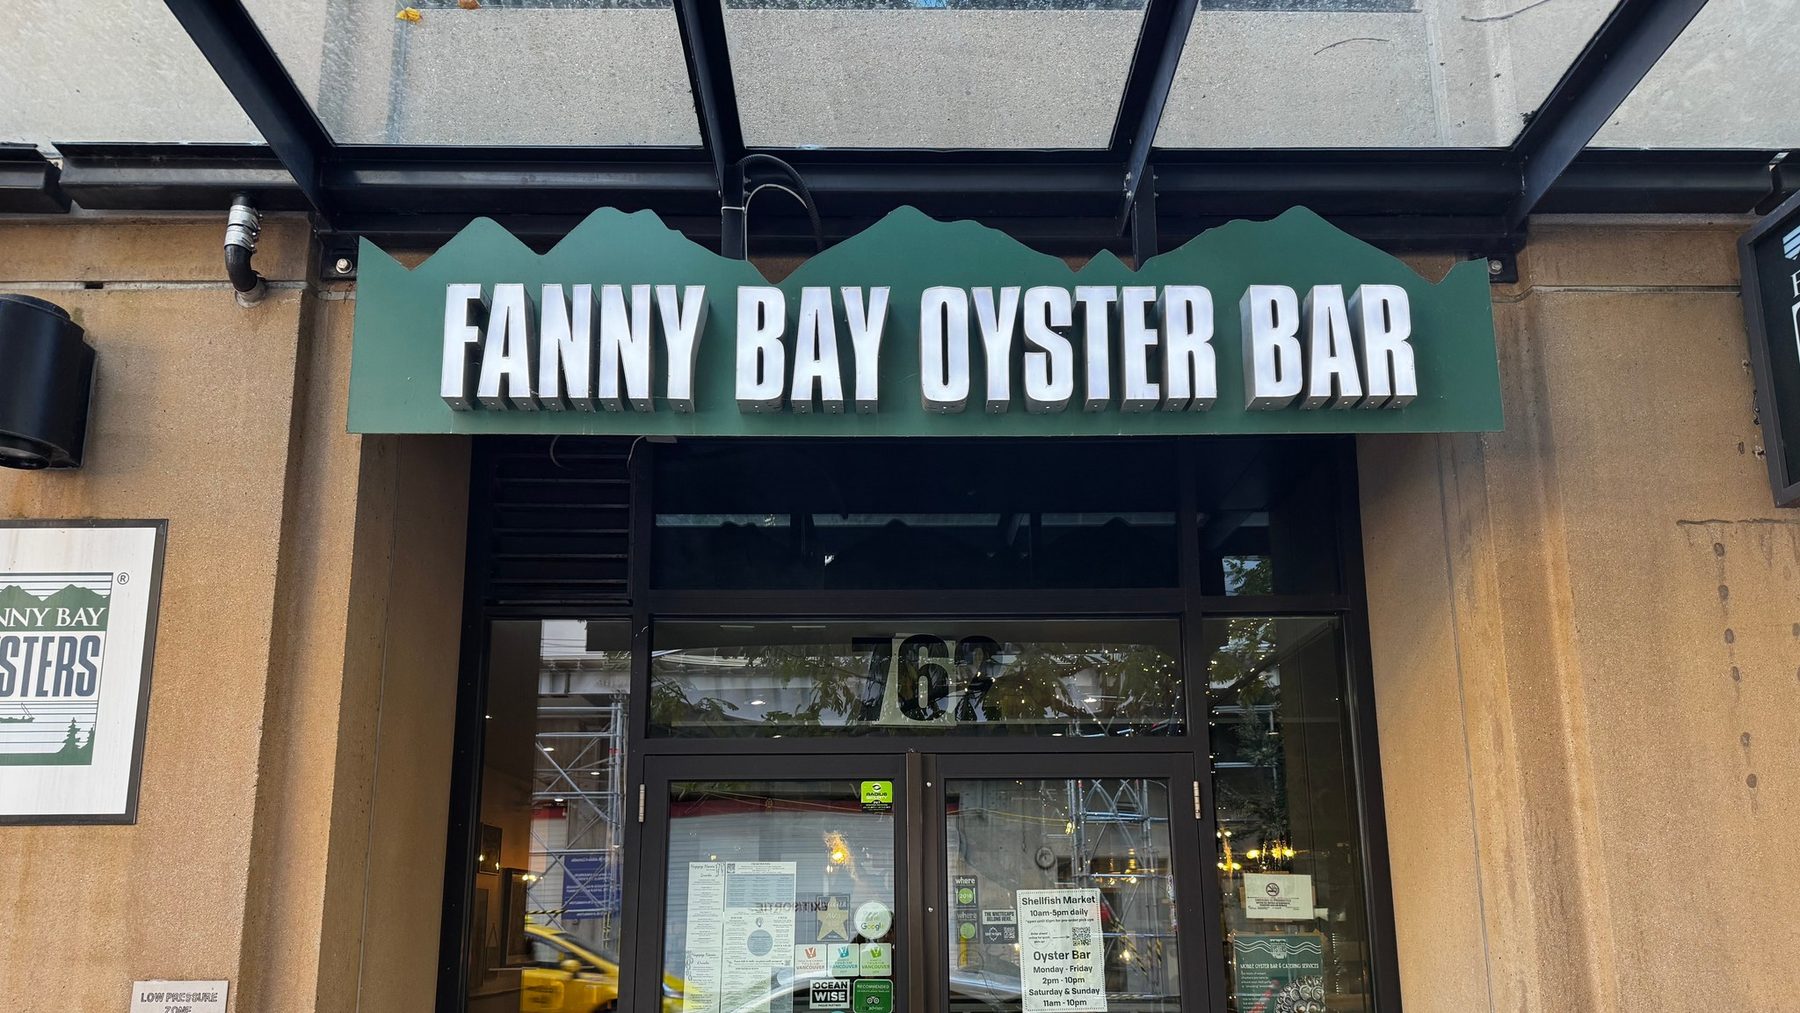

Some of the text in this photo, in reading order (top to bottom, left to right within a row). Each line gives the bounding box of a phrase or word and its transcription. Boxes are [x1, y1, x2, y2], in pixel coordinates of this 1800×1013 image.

[440, 283, 1419, 408] FANNY BAY OYSTER BAR
[56, 607, 107, 627] BAY
[852, 634, 1003, 721] 762
[1022, 895, 1096, 906] Shellfish Market
[1030, 908, 1088, 918] 10am-5pm daily
[860, 922, 885, 931] Googl
[1033, 950, 1091, 963] Oyster Bar
[1033, 966, 1064, 974] Monday
[1042, 977, 1059, 985] 2pm
[140, 992, 218, 1003] LOW PRESSURE
[814, 992, 846, 1001] WISE
